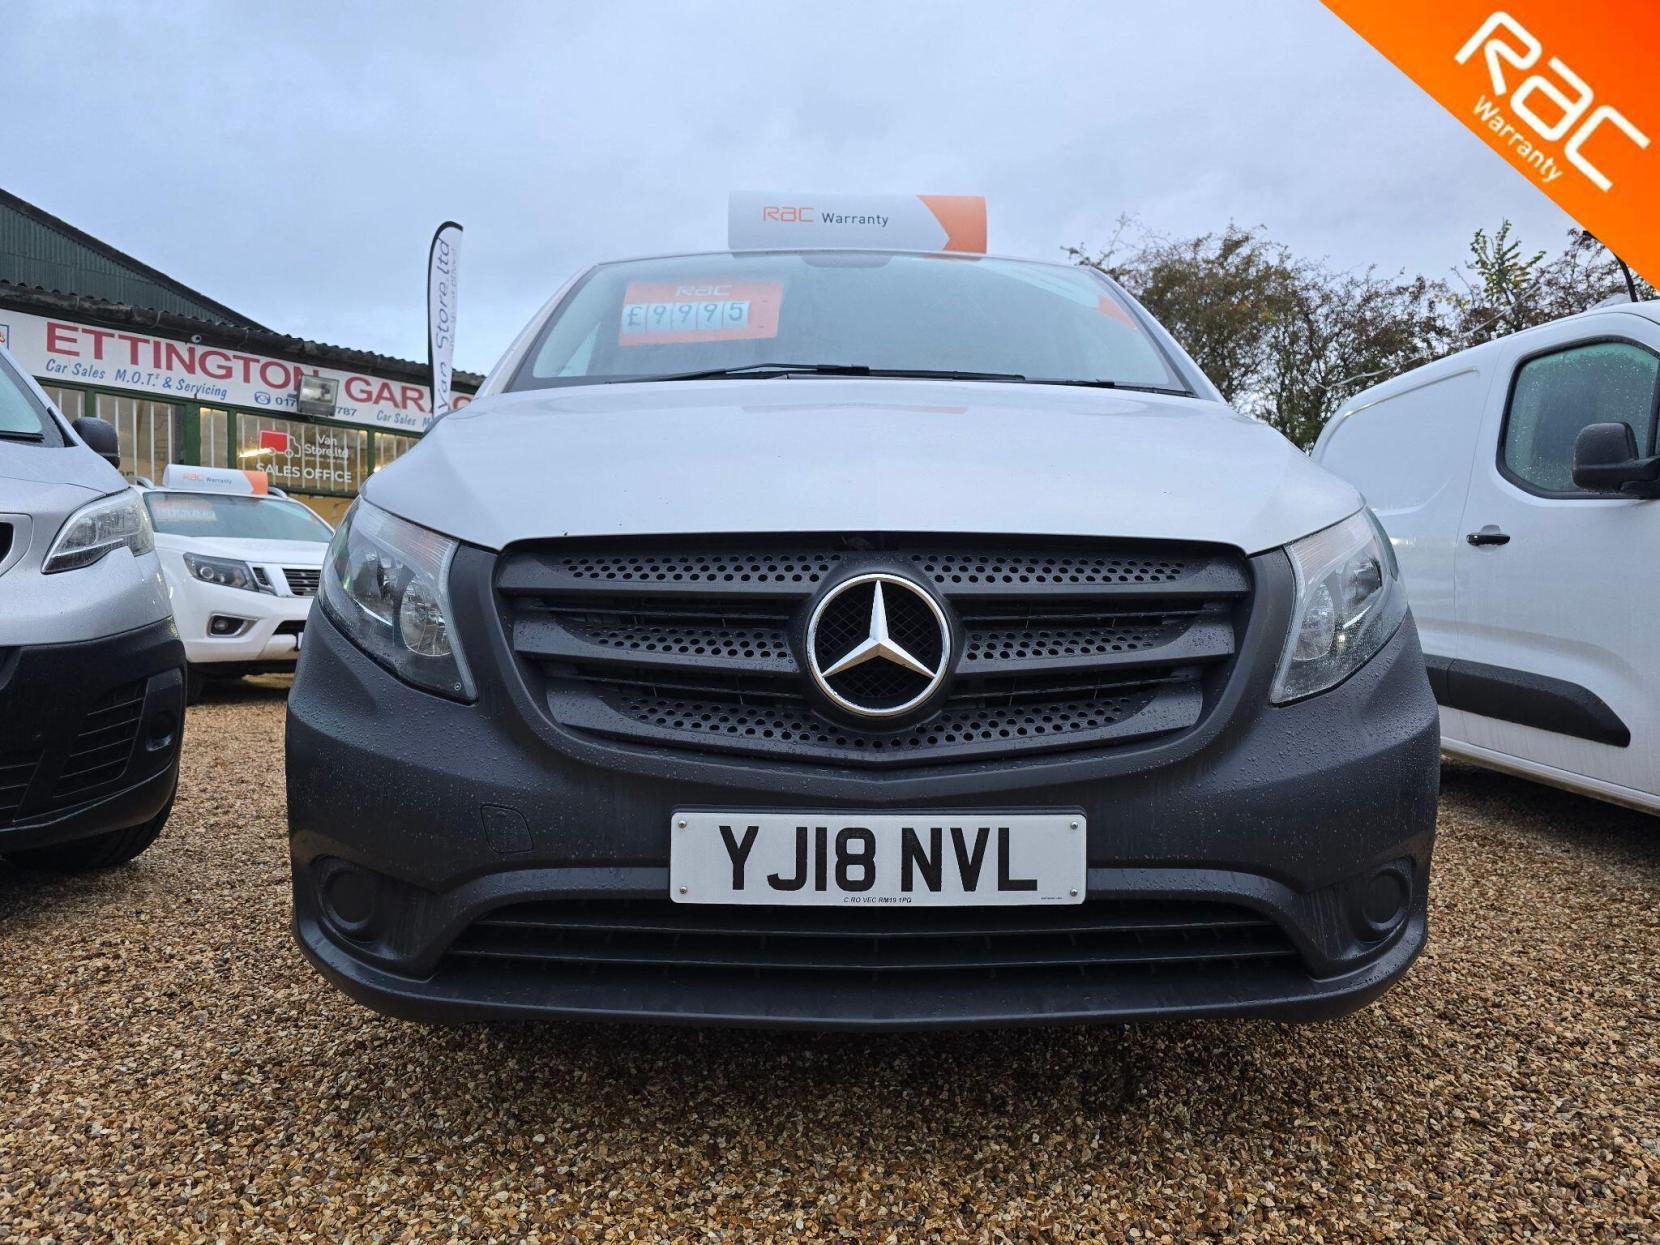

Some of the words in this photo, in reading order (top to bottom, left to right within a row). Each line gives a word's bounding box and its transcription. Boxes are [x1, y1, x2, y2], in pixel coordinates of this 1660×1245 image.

[821, 212, 889, 228] Warranty
[46, 358, 68, 374] Car
[72, 362, 106, 380] Sales
[162, 376, 173, 389] &
[176, 378, 228, 401] Servicing
[437, 361, 449, 409] Van
[376, 409, 391, 422] Car
[394, 411, 417, 427] Sales
[316, 433, 338, 447] Van
[256, 462, 301, 478] SALES
[303, 467, 353, 484] OFFICE
[718, 825, 877, 893] YJ18
[901, 827, 1039, 893] NVL
